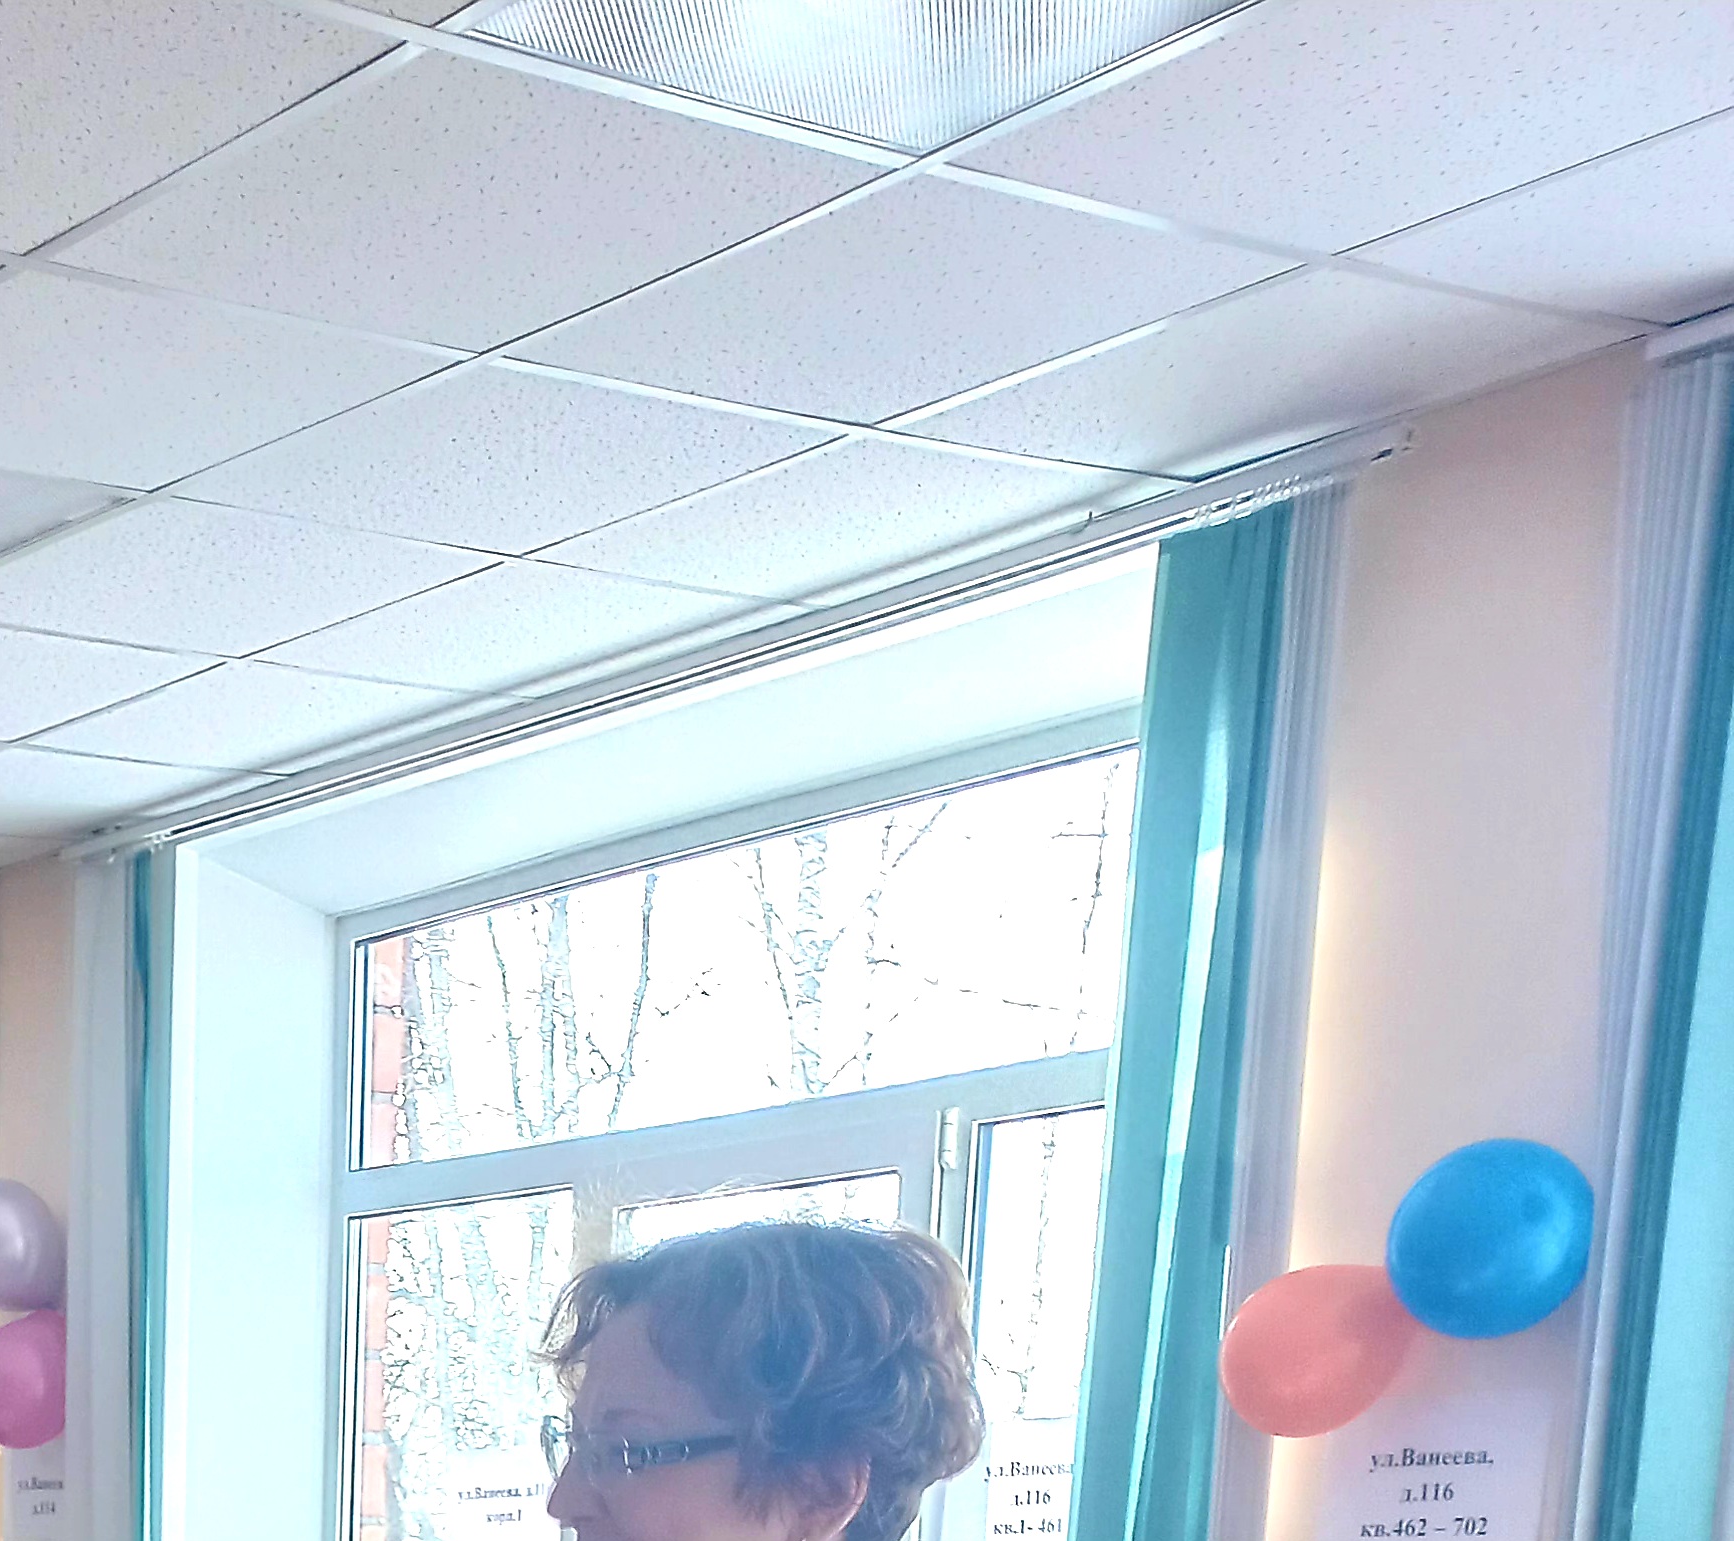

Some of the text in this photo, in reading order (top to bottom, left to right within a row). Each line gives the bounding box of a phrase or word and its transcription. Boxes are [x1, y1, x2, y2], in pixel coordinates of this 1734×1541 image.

[1369, 1447, 1494, 1472] ул.Ванеева,
[1400, 1482, 1455, 1502] д.116
[1360, 1516, 1427, 1538] кв.462
[1453, 1516, 1489, 1537] 702
